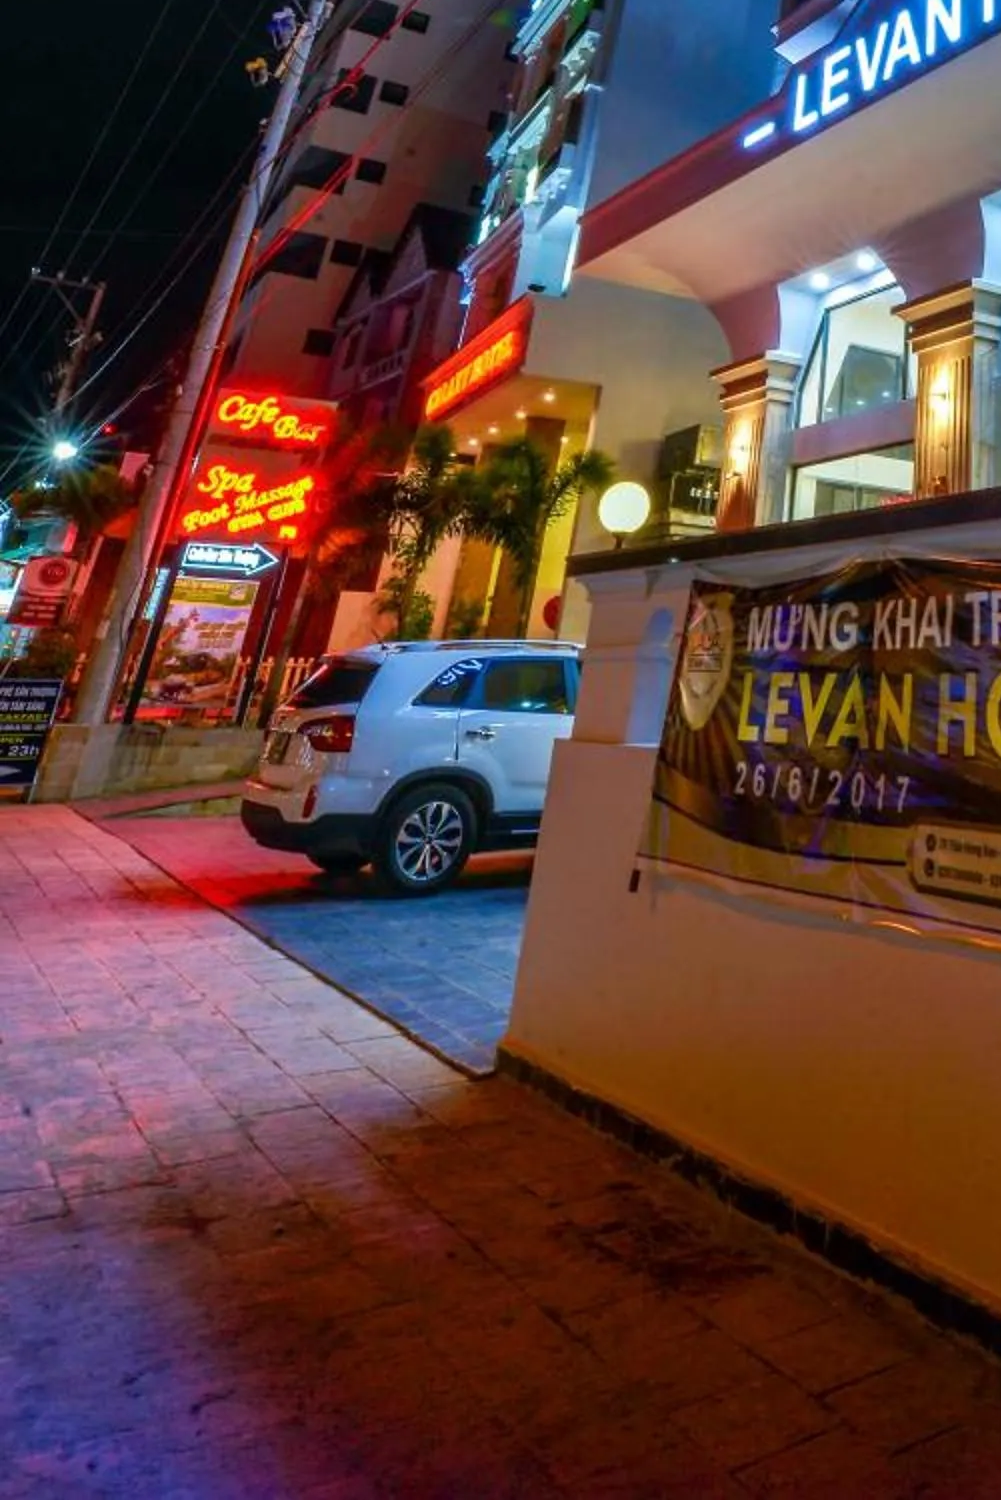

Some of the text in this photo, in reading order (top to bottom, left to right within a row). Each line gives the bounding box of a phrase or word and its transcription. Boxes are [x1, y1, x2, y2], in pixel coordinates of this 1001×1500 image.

[218, 395, 281, 430] Cafe
[273, 415, 326, 442] Bar
[182, 475, 314, 532] Foot Massage
[197, 465, 256, 499] Spa
[872, 594, 953, 651] KHAI
[737, 667, 914, 754] LEVAN
[734, 762, 911, 814] 26/6/2017
